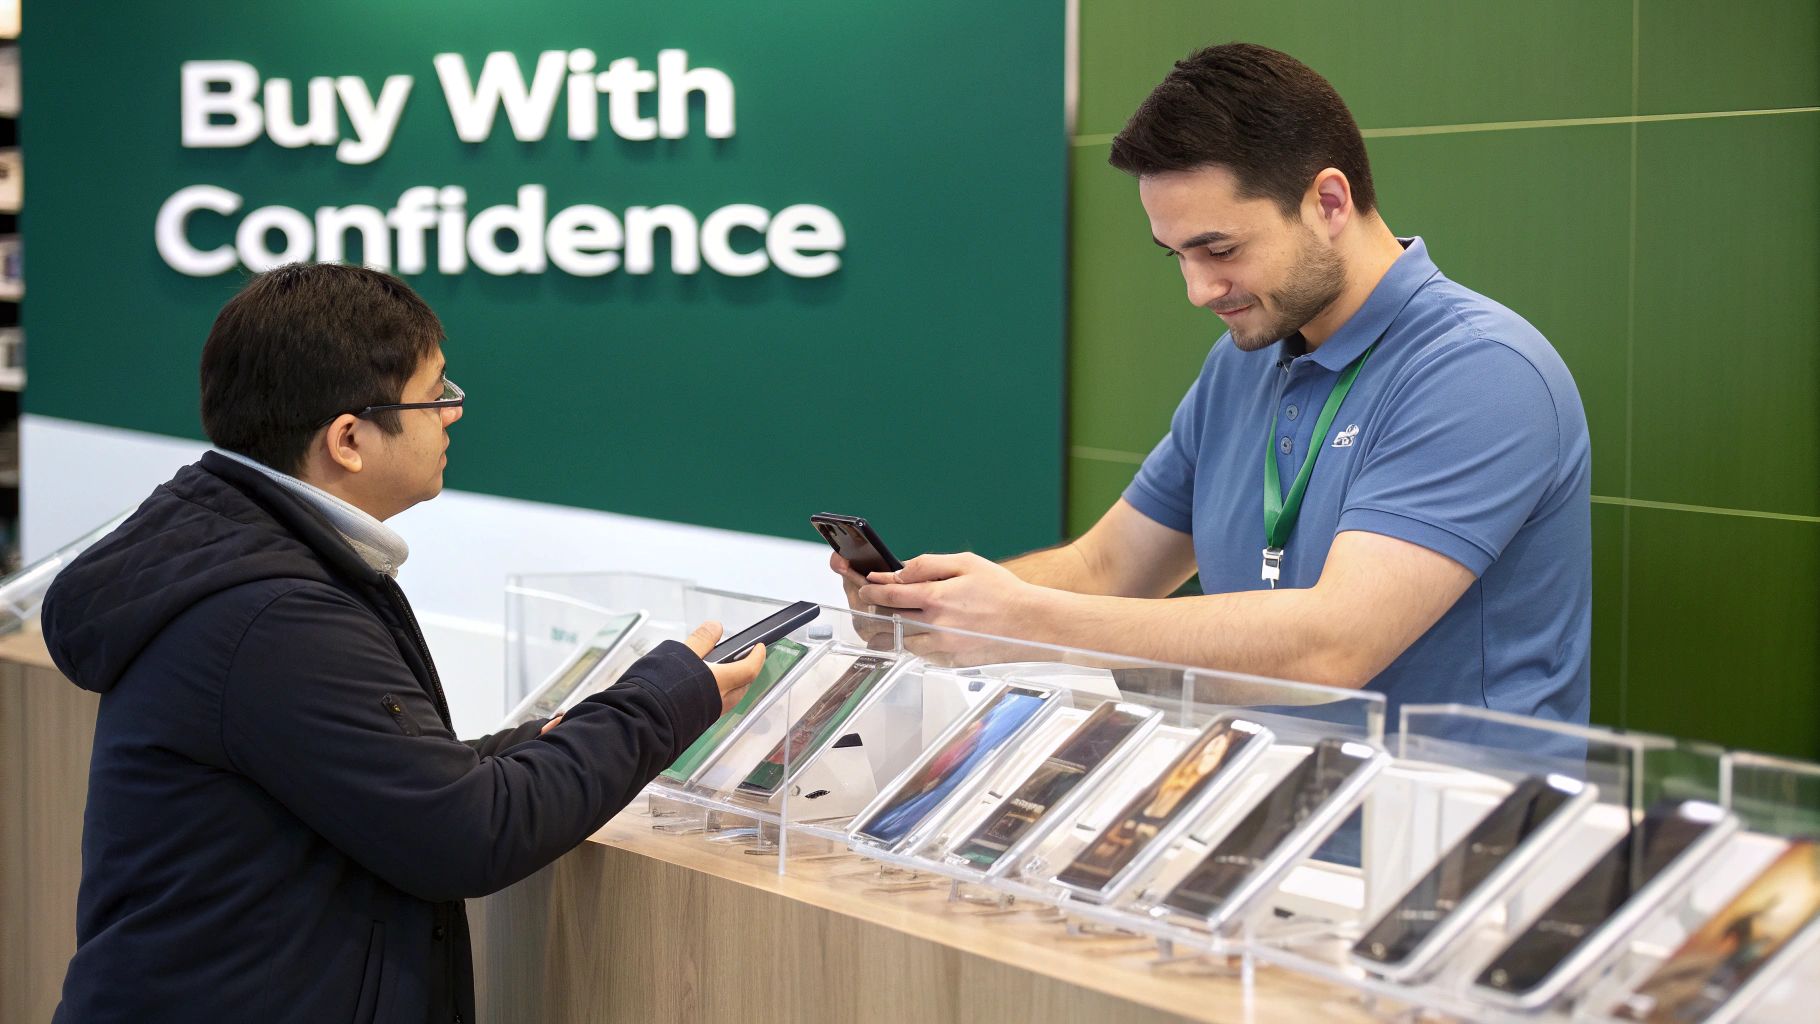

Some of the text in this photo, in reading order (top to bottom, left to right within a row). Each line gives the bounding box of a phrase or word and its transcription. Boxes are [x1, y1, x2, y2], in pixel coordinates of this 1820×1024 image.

[181, 48, 736, 164] Buy With
[155, 184, 846, 278] Confidence
